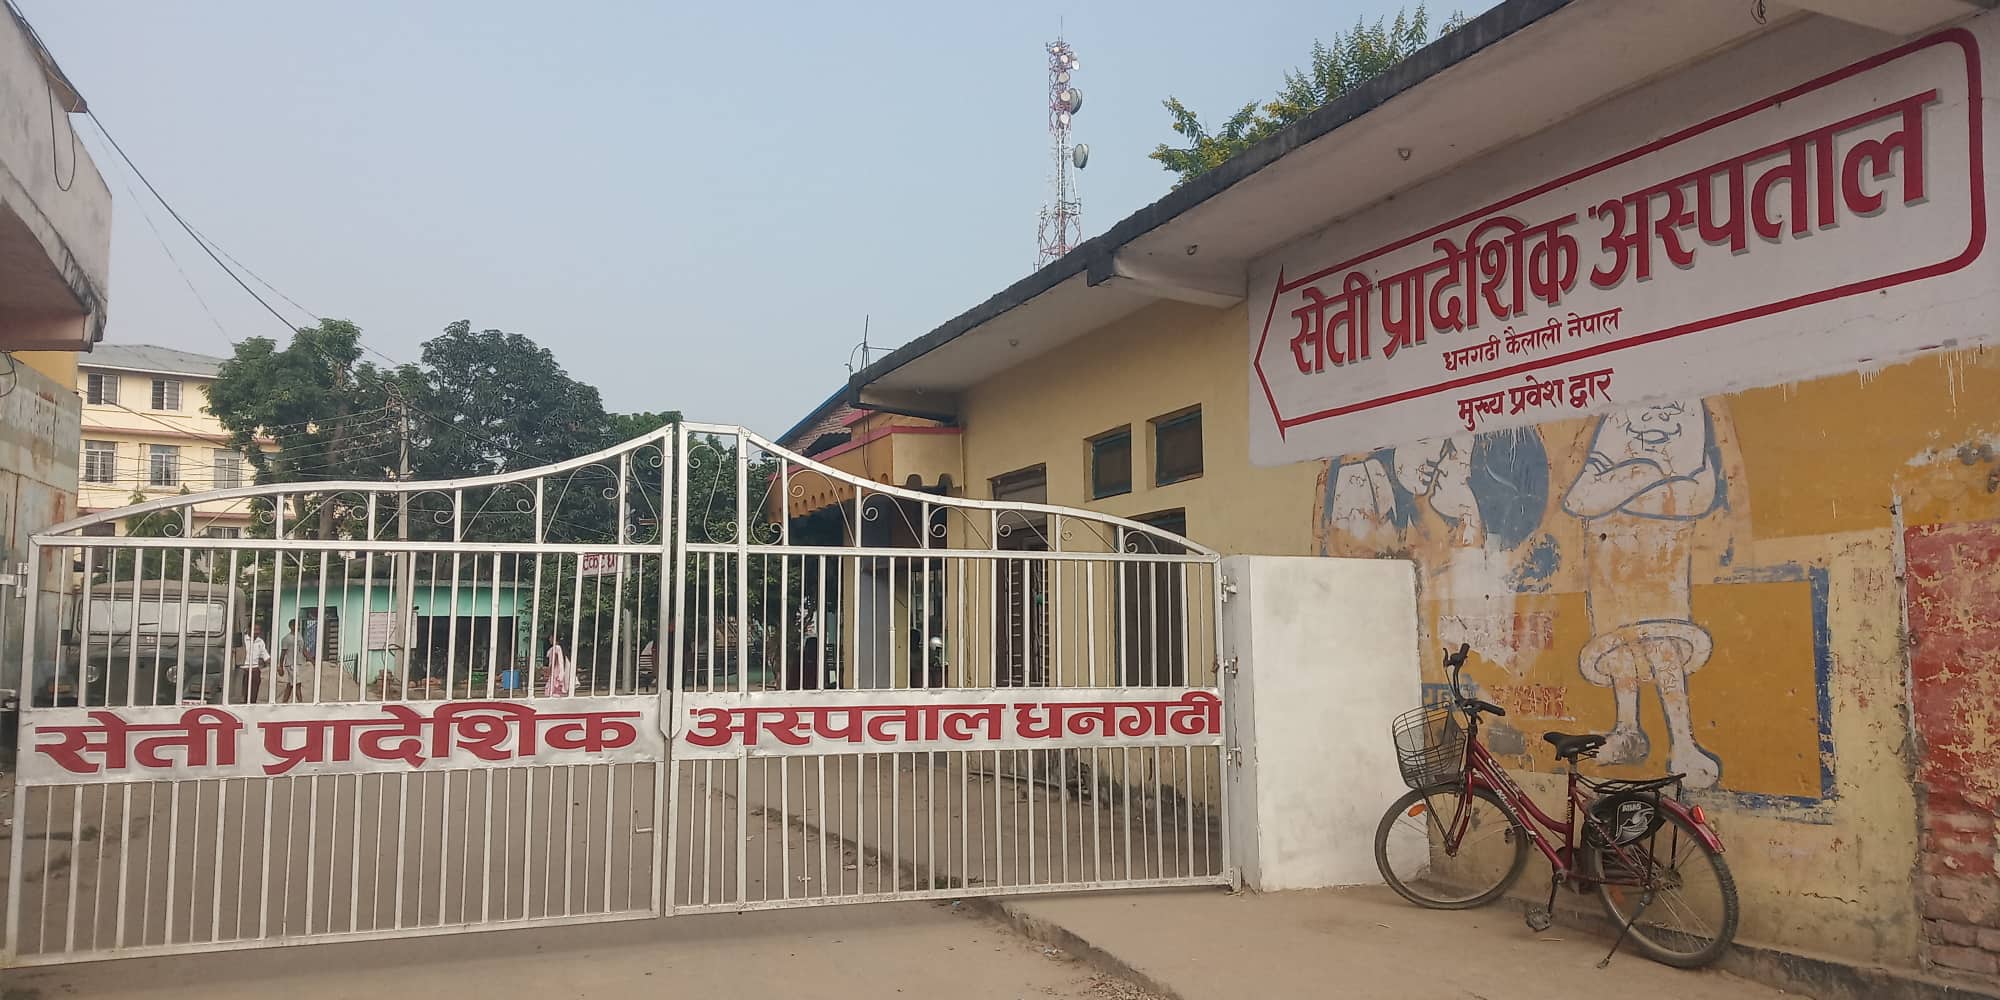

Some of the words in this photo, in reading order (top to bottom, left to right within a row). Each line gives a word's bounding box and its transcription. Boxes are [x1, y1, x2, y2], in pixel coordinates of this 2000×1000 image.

[1290, 271, 1372, 374] सेती
[1378, 213, 1579, 359] प्रादेशिक
[1588, 88, 1937, 289] अस्पताल
[1443, 335, 1501, 371] धनगढी
[1504, 317, 1562, 355] कैलाली
[1568, 307, 1623, 338] नेपाल
[1457, 391, 1505, 431] मुख्य
[1508, 375, 1564, 415] प्रवेश
[1568, 368, 1614, 408] द्वार
[35, 708, 243, 774] सेती
[258, 702, 641, 775] प्रादेशिक
[686, 703, 1006, 746] अस्पताल
[1015, 691, 1223, 738] धनगढी
